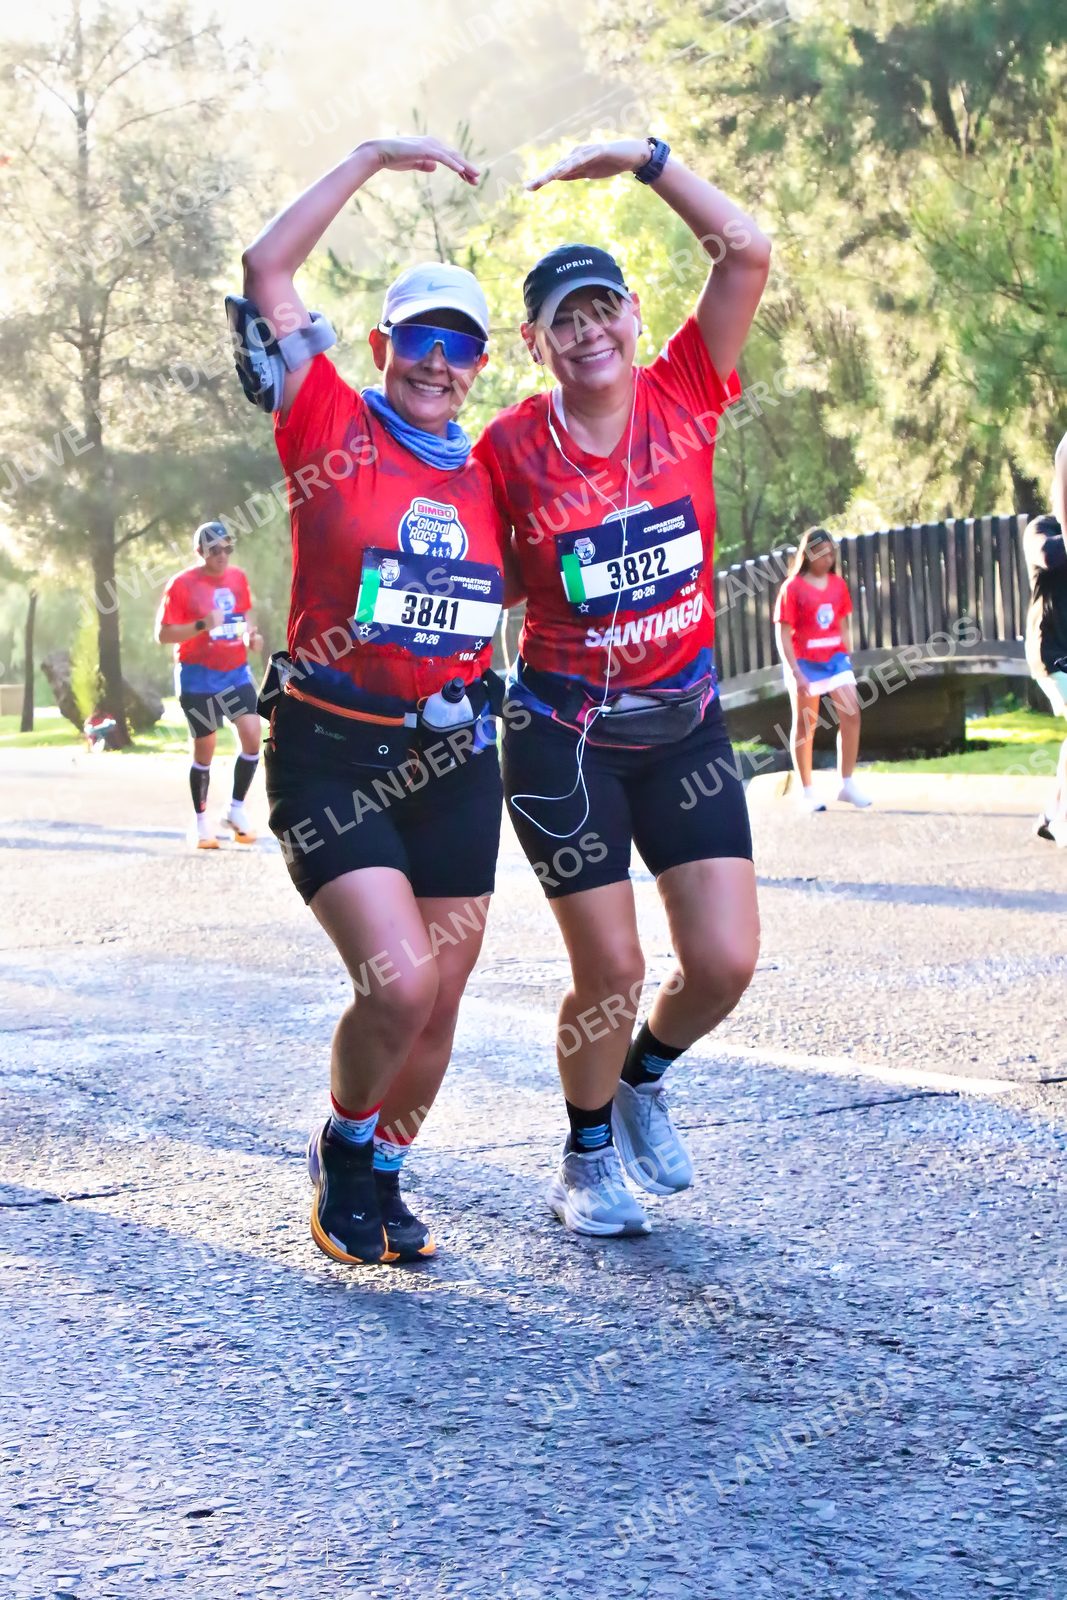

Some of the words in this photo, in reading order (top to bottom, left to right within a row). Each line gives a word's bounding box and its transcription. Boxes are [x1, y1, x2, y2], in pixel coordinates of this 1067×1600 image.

[555, 258, 594, 274] KIPRUN
[417, 504, 453, 518] BIMBO
[417, 517, 451, 535] Global
[409, 528, 438, 542] Race
[607, 547, 670, 591] 3822
[679, 582, 697, 597] 10K
[401, 594, 459, 631] 3841
[584, 592, 704, 648] SANTIAGO
